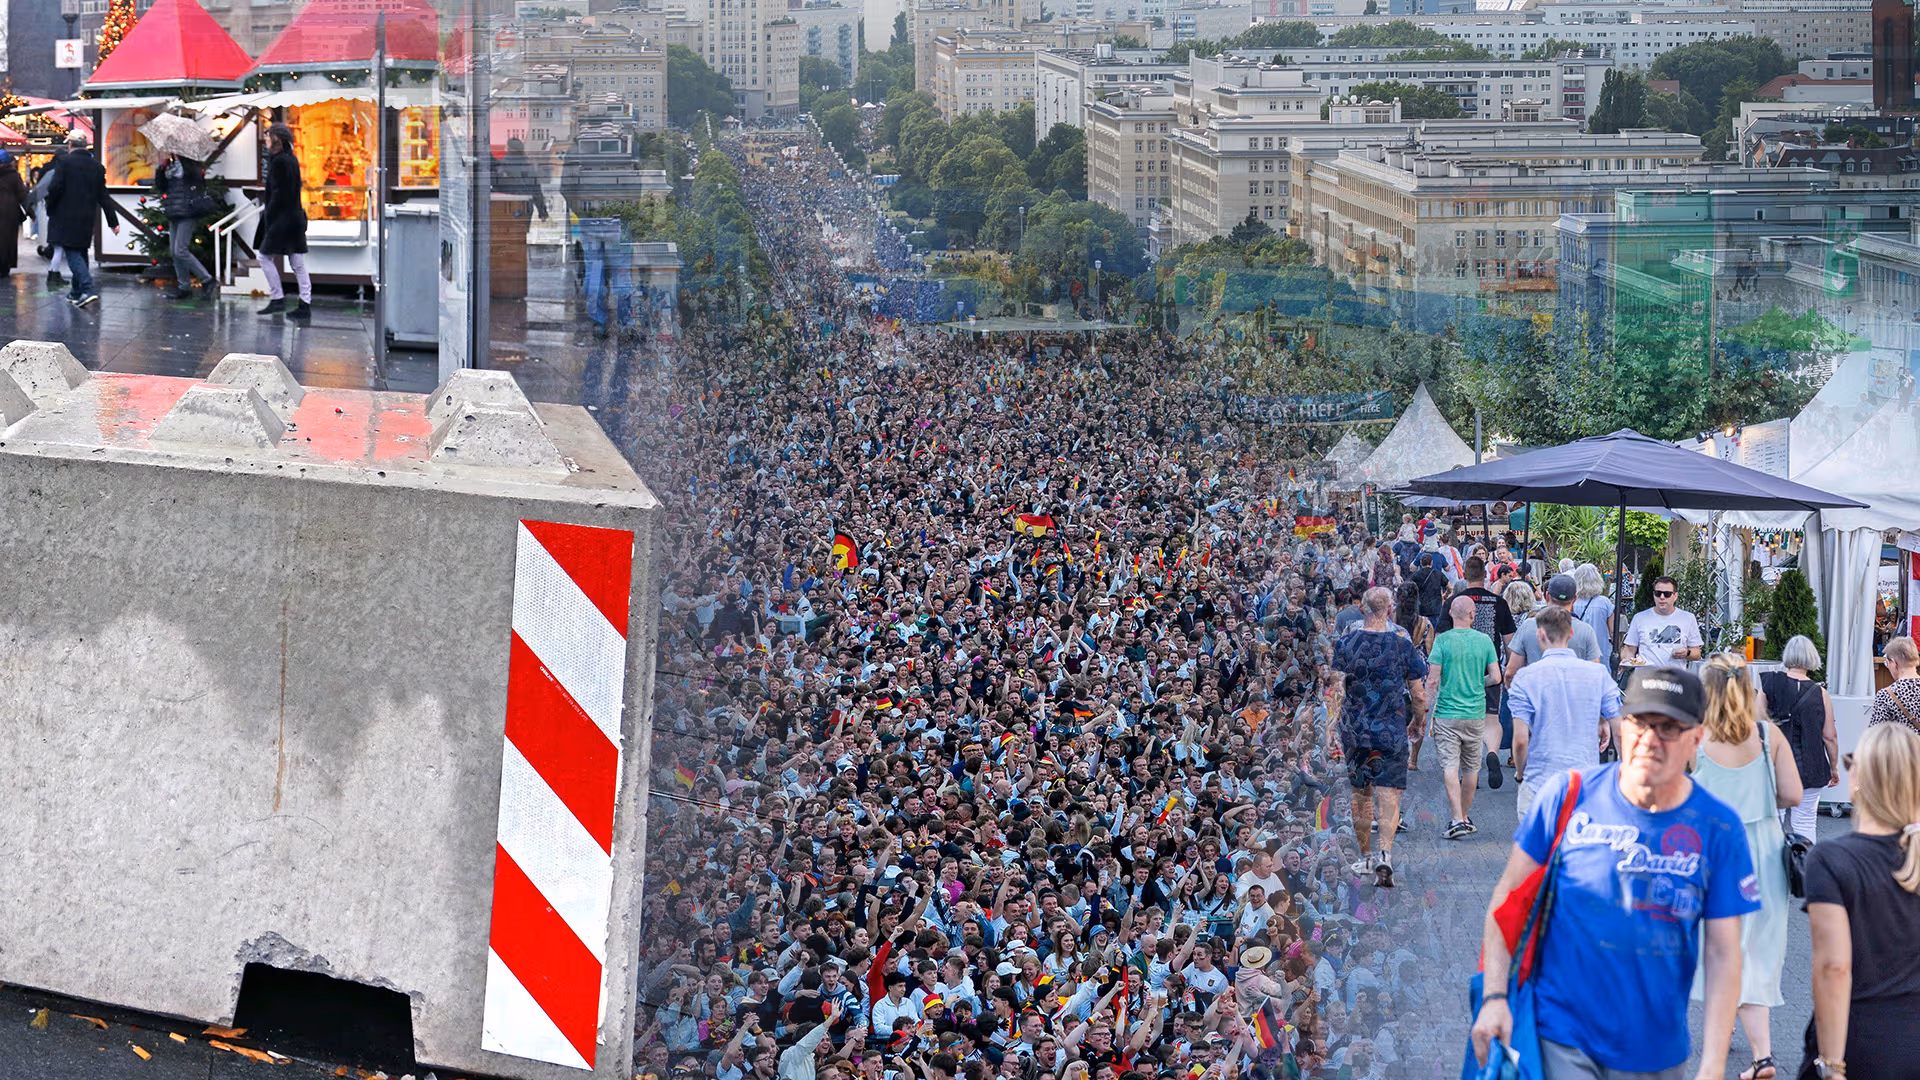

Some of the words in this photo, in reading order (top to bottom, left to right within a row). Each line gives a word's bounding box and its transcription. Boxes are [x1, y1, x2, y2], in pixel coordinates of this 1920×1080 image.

[1360, 403, 1381, 414] FIEGE
[1567, 812, 1640, 851] Camp
[1617, 843, 1700, 877] David
